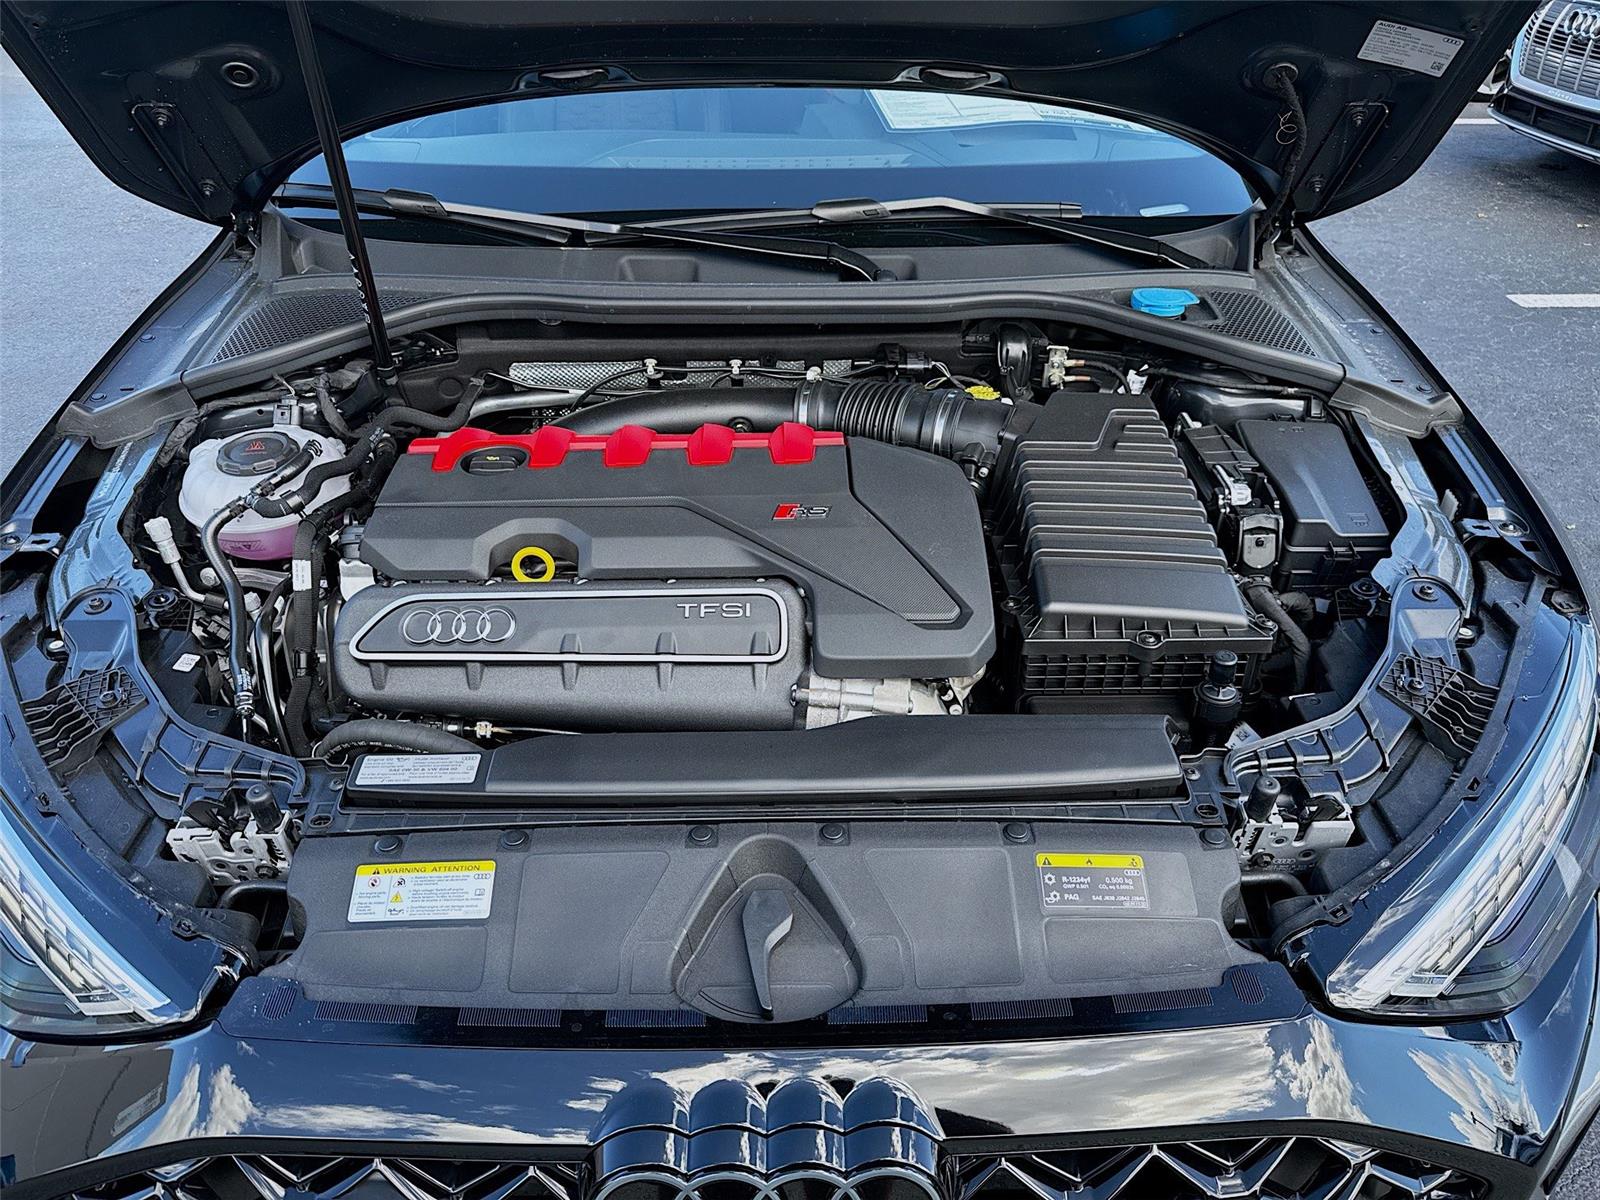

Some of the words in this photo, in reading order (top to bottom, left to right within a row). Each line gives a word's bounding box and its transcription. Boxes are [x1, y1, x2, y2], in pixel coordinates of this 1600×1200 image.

[676, 603, 751, 619] TFSI
[384, 867, 427, 875] WARNING
[431, 865, 481, 873] ATTENTION
[1061, 876, 1091, 884] R-1234yf
[1124, 877, 1133, 885] kg
[1064, 893, 1080, 901] PAG
